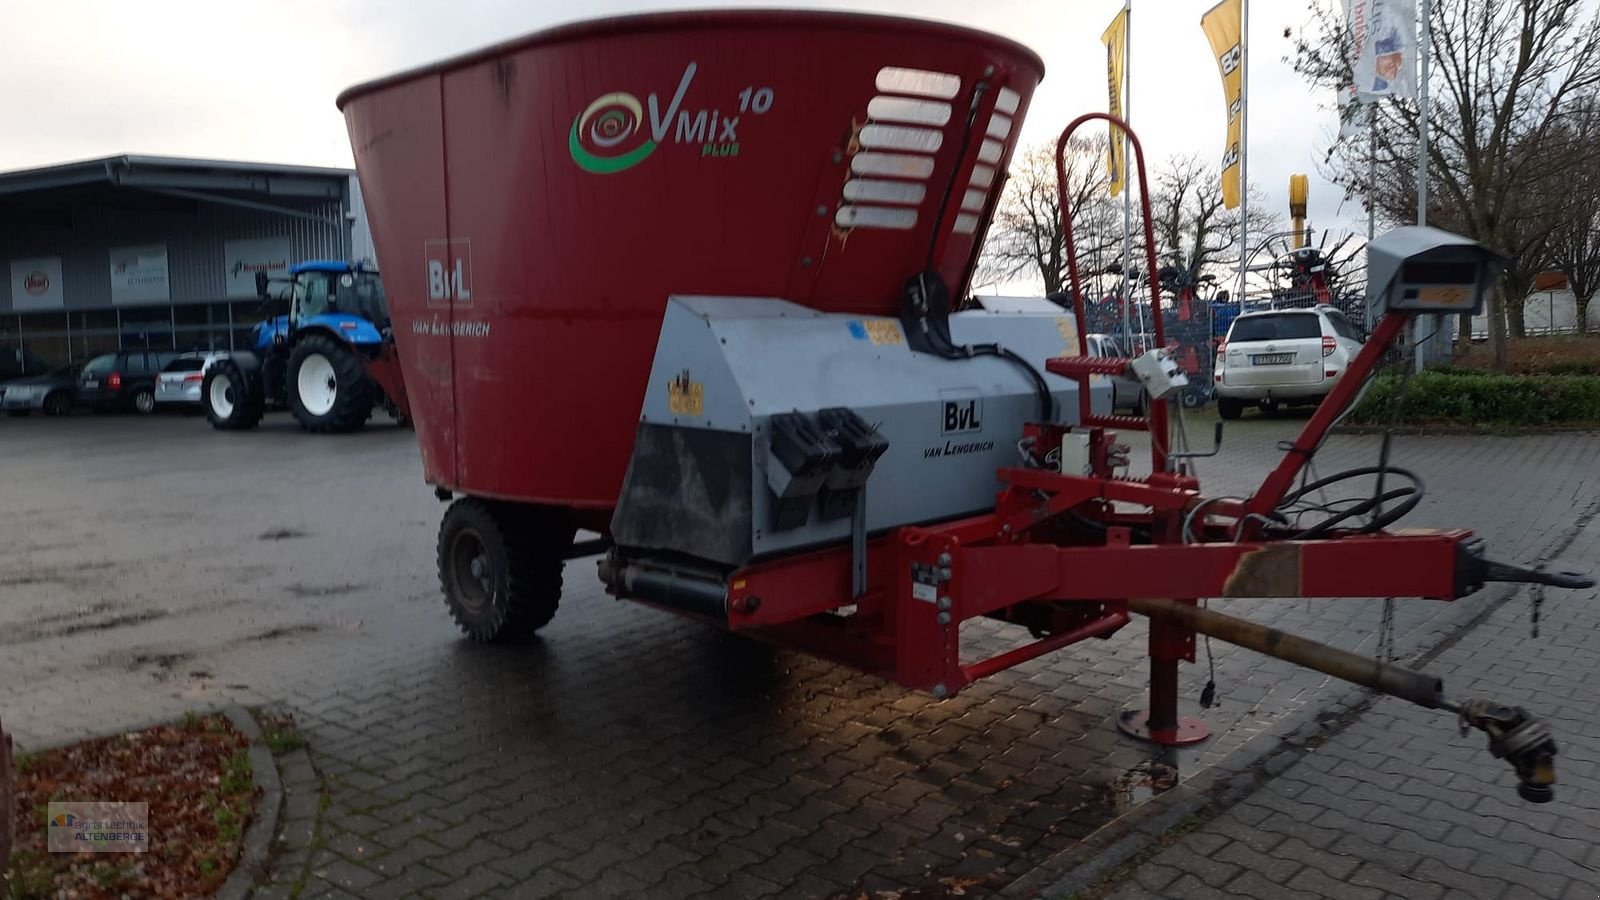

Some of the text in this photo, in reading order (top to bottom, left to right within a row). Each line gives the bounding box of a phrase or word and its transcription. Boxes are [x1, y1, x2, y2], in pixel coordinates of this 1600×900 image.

[738, 86, 775, 114] 10
[702, 142, 740, 157] PLUS
[428, 258, 471, 300] BvL
[412, 320, 429, 334] VAN
[944, 400, 980, 432] BvL
[924, 440, 995, 459] VAN LENGERICH
